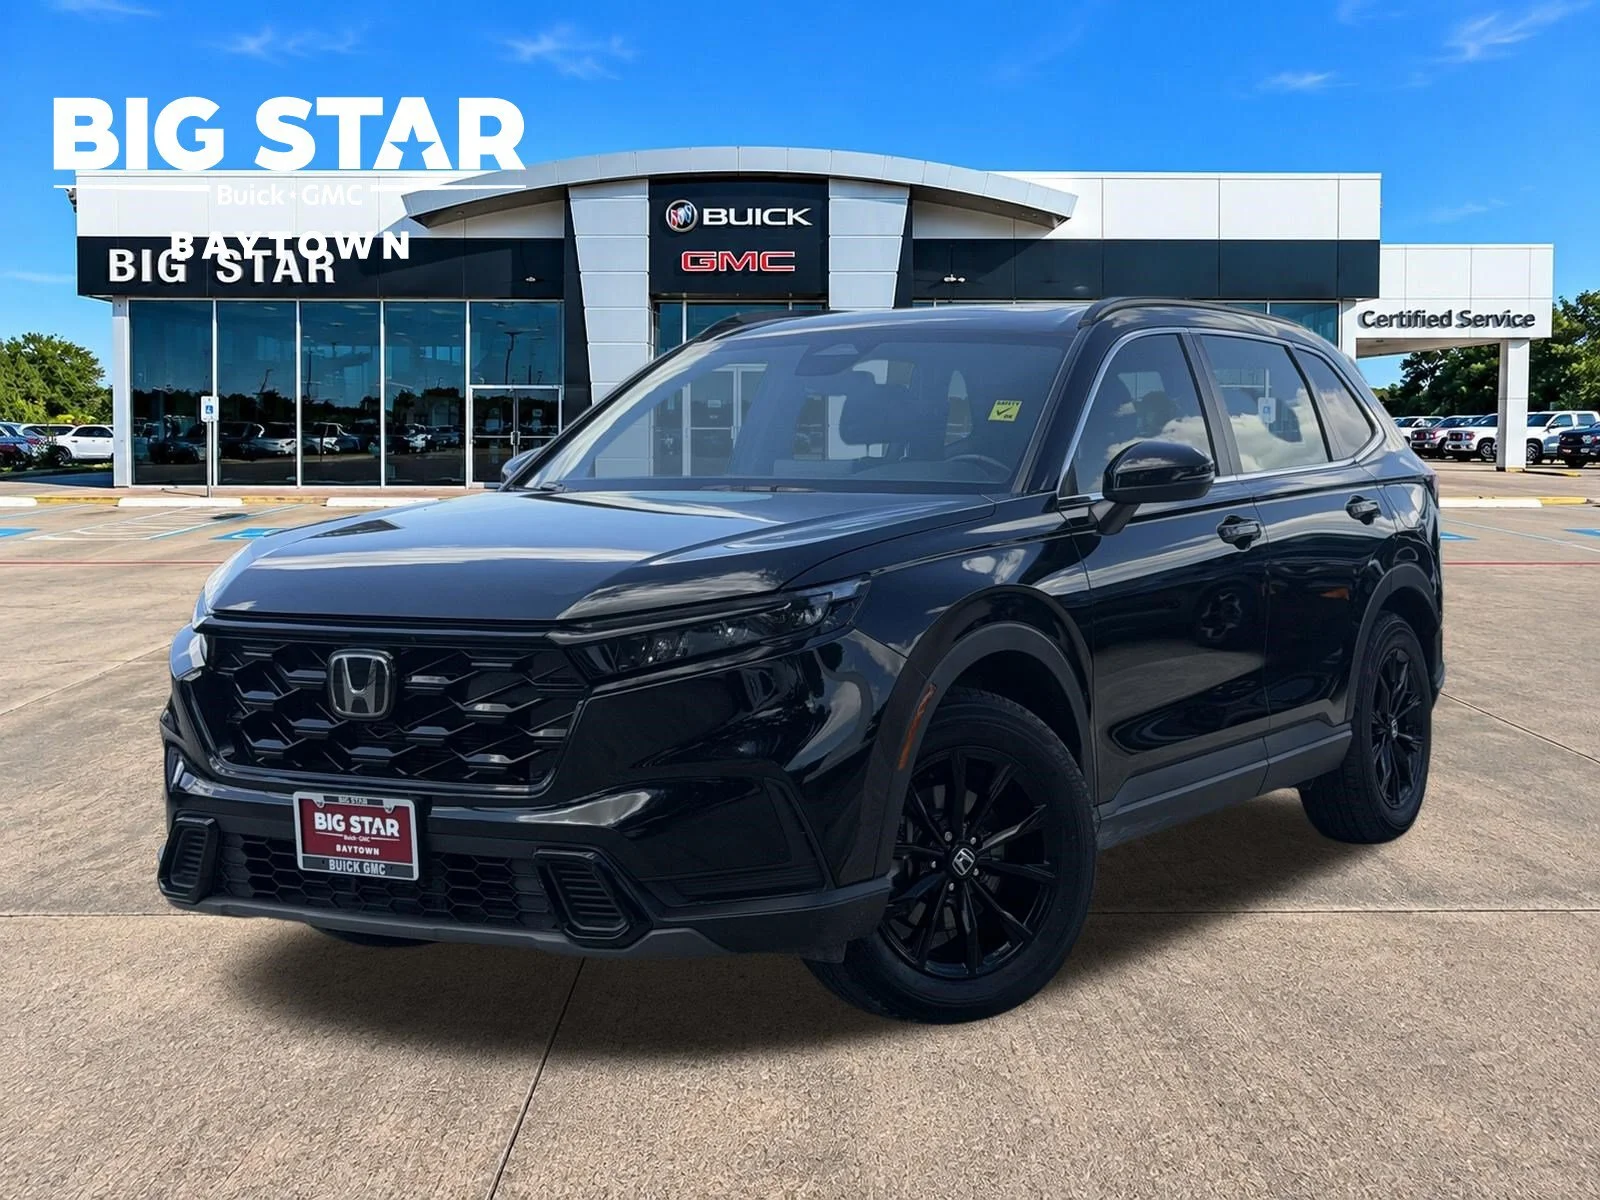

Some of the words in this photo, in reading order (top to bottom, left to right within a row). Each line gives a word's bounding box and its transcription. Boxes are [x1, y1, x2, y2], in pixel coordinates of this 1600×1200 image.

[702, 207, 814, 226] BUICK
[108, 248, 188, 283] BIG
[215, 248, 336, 284] STAR
[681, 250, 796, 272] GMC
[1359, 309, 1453, 328] Certified
[1455, 309, 1536, 328] Service
[314, 812, 346, 833] BIG
[349, 815, 400, 838] STAR
[336, 844, 380, 856] BAYTOWN
[328, 859, 361, 873] BUICK
[363, 862, 386, 875] GMC
